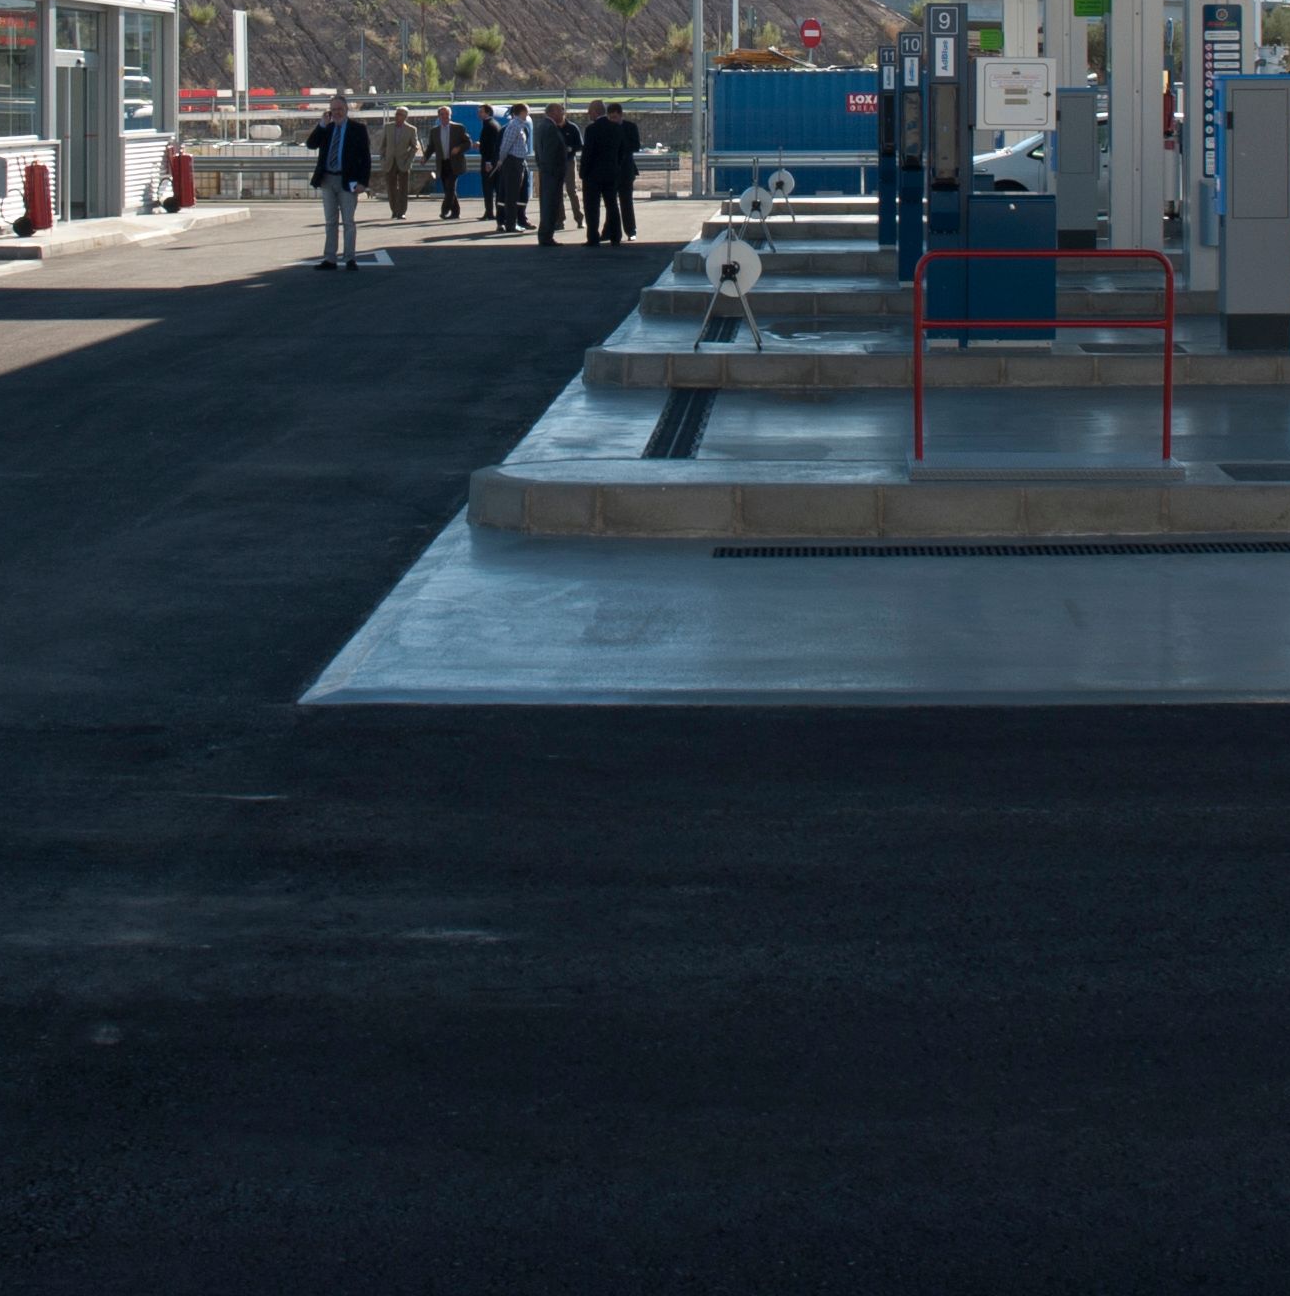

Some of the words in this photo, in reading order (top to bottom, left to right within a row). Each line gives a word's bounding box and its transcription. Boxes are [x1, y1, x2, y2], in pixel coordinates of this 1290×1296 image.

[938, 12, 951, 29] 9
[903, 38, 920, 51] 10
[883, 51, 895, 62] 11
